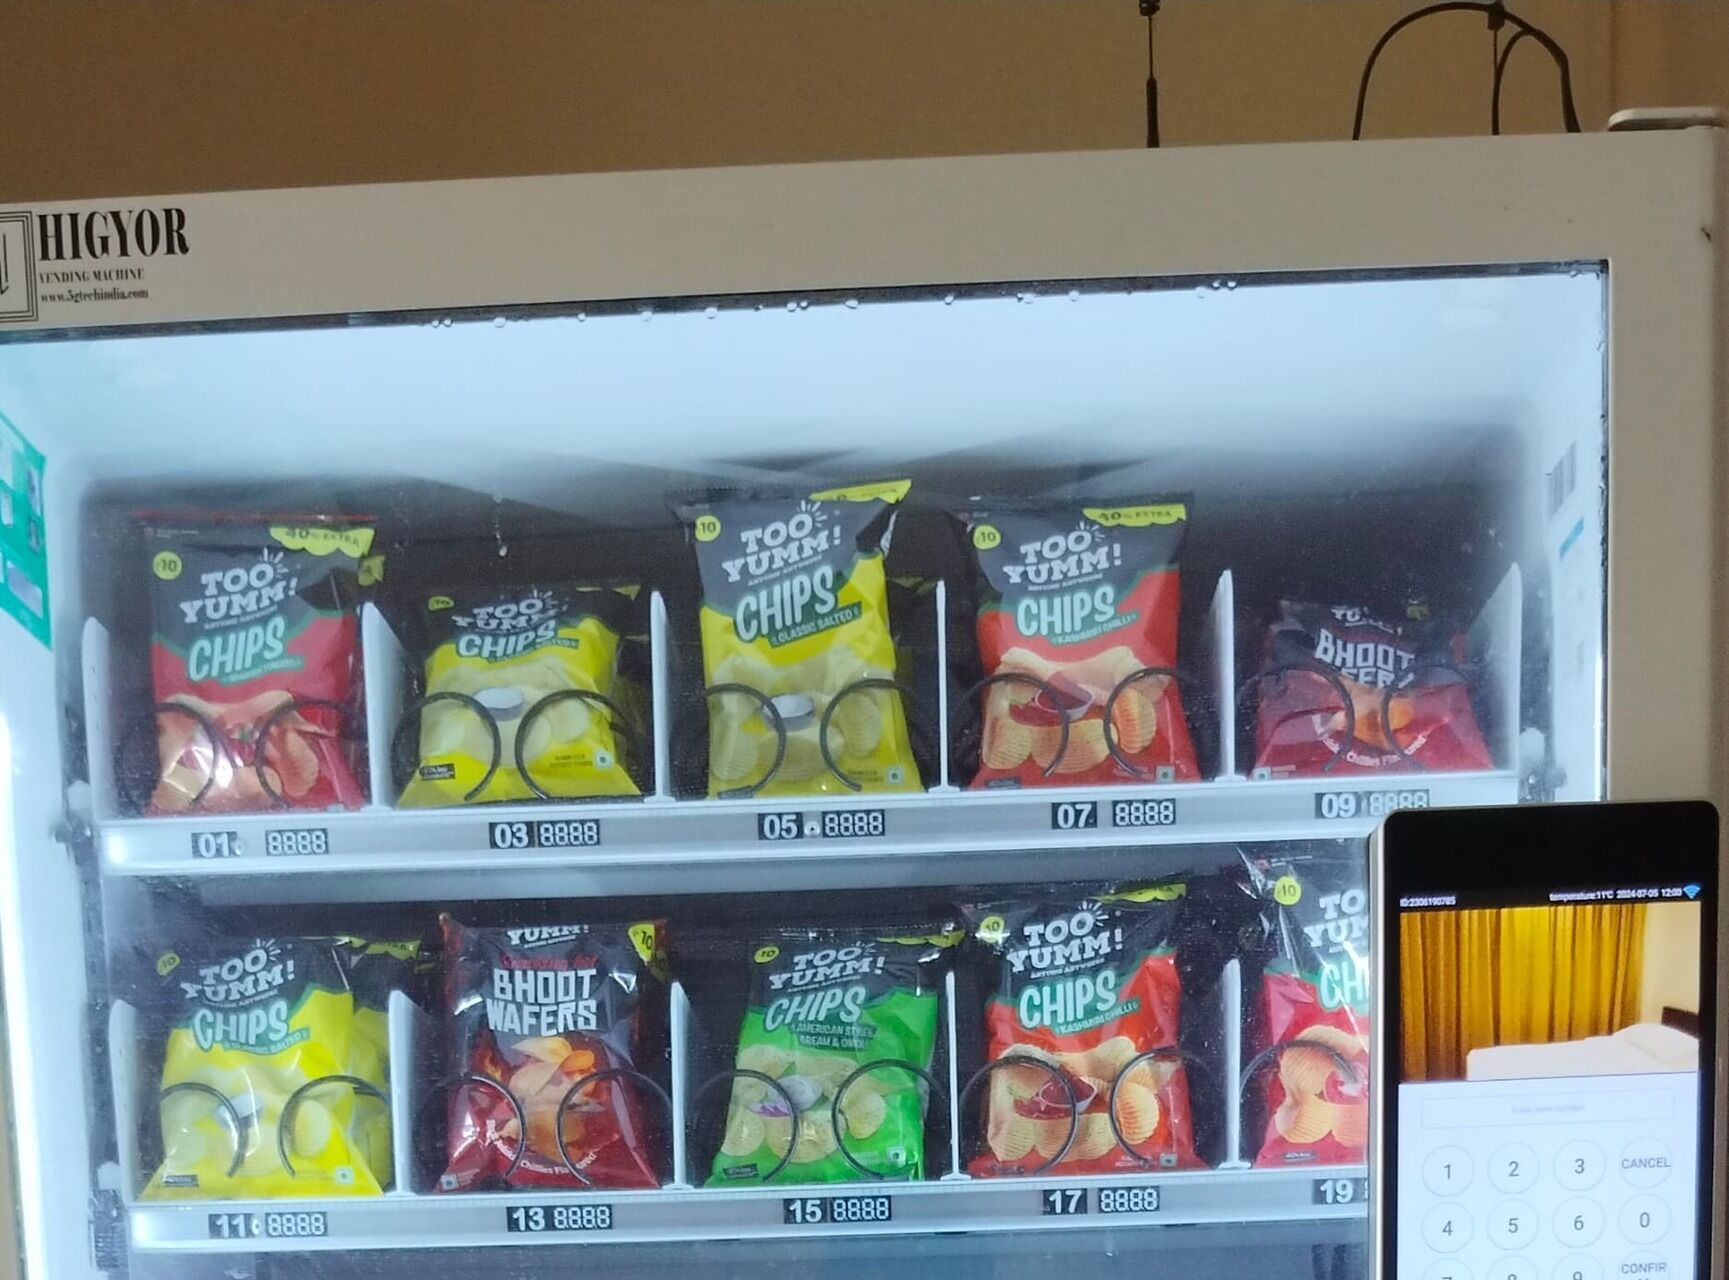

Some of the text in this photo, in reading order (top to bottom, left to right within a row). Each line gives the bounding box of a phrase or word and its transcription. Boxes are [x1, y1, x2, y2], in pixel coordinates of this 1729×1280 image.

[37, 207, 190, 261] HIGYOR
[39, 268, 145, 284] VENDING MACHINE
[41, 287, 149, 303] www.5gtechindia.com
[700, 522, 716, 534] 10
[740, 513, 812, 554] TOO
[981, 532, 996, 543] 10
[722, 525, 841, 584] YUMM!
[1020, 530, 1092, 564] TOO
[160, 560, 178, 573] 10
[1003, 543, 1122, 584] YUMM!
[201, 563, 274, 597] TOO
[179, 577, 298, 623] YUMM!
[473, 598, 543, 619] TOO
[736, 565, 834, 641] CHIPS
[1017, 586, 1116, 637] CHIPS
[188, 616, 285, 681] CHIPS
[458, 620, 556, 658] CHIPS
[1314, 627, 1415, 671] BHOOT
[1057, 803, 1092, 829] 07
[1321, 793, 1356, 819] 09
[494, 823, 529, 849] 03
[763, 814, 798, 840] 05
[200, 832, 230, 858] 01
[1281, 884, 1297, 897] 10
[507, 924, 590, 946] YUMM!
[1023, 911, 1095, 948] TOO
[794, 947, 861, 971] TOO
[1006, 928, 1123, 973] YUMM!
[181, 960, 295, 1002] YUMM!
[199, 949, 267, 986] TOO
[769, 957, 885, 990] YUMM!
[494, 968, 597, 1004] BHOOT
[1020, 970, 1117, 1029] CHIPS
[487, 998, 597, 1037] WAFERS
[765, 986, 866, 1031] CHIPS
[193, 998, 288, 1050] CHIPS
[1443, 1156, 1671, 1180] 1 2 3 CANCEL
[1049, 1189, 1082, 1214] 17
[1320, 1179, 1354, 1204] 19
[512, 1207, 545, 1231] 13
[789, 1199, 822, 1223] 15
[1442, 1211, 1650, 1236] 4 5 6 0
[215, 1214, 246, 1238] 11
[1621, 1262, 1667, 1275] CONFIR
